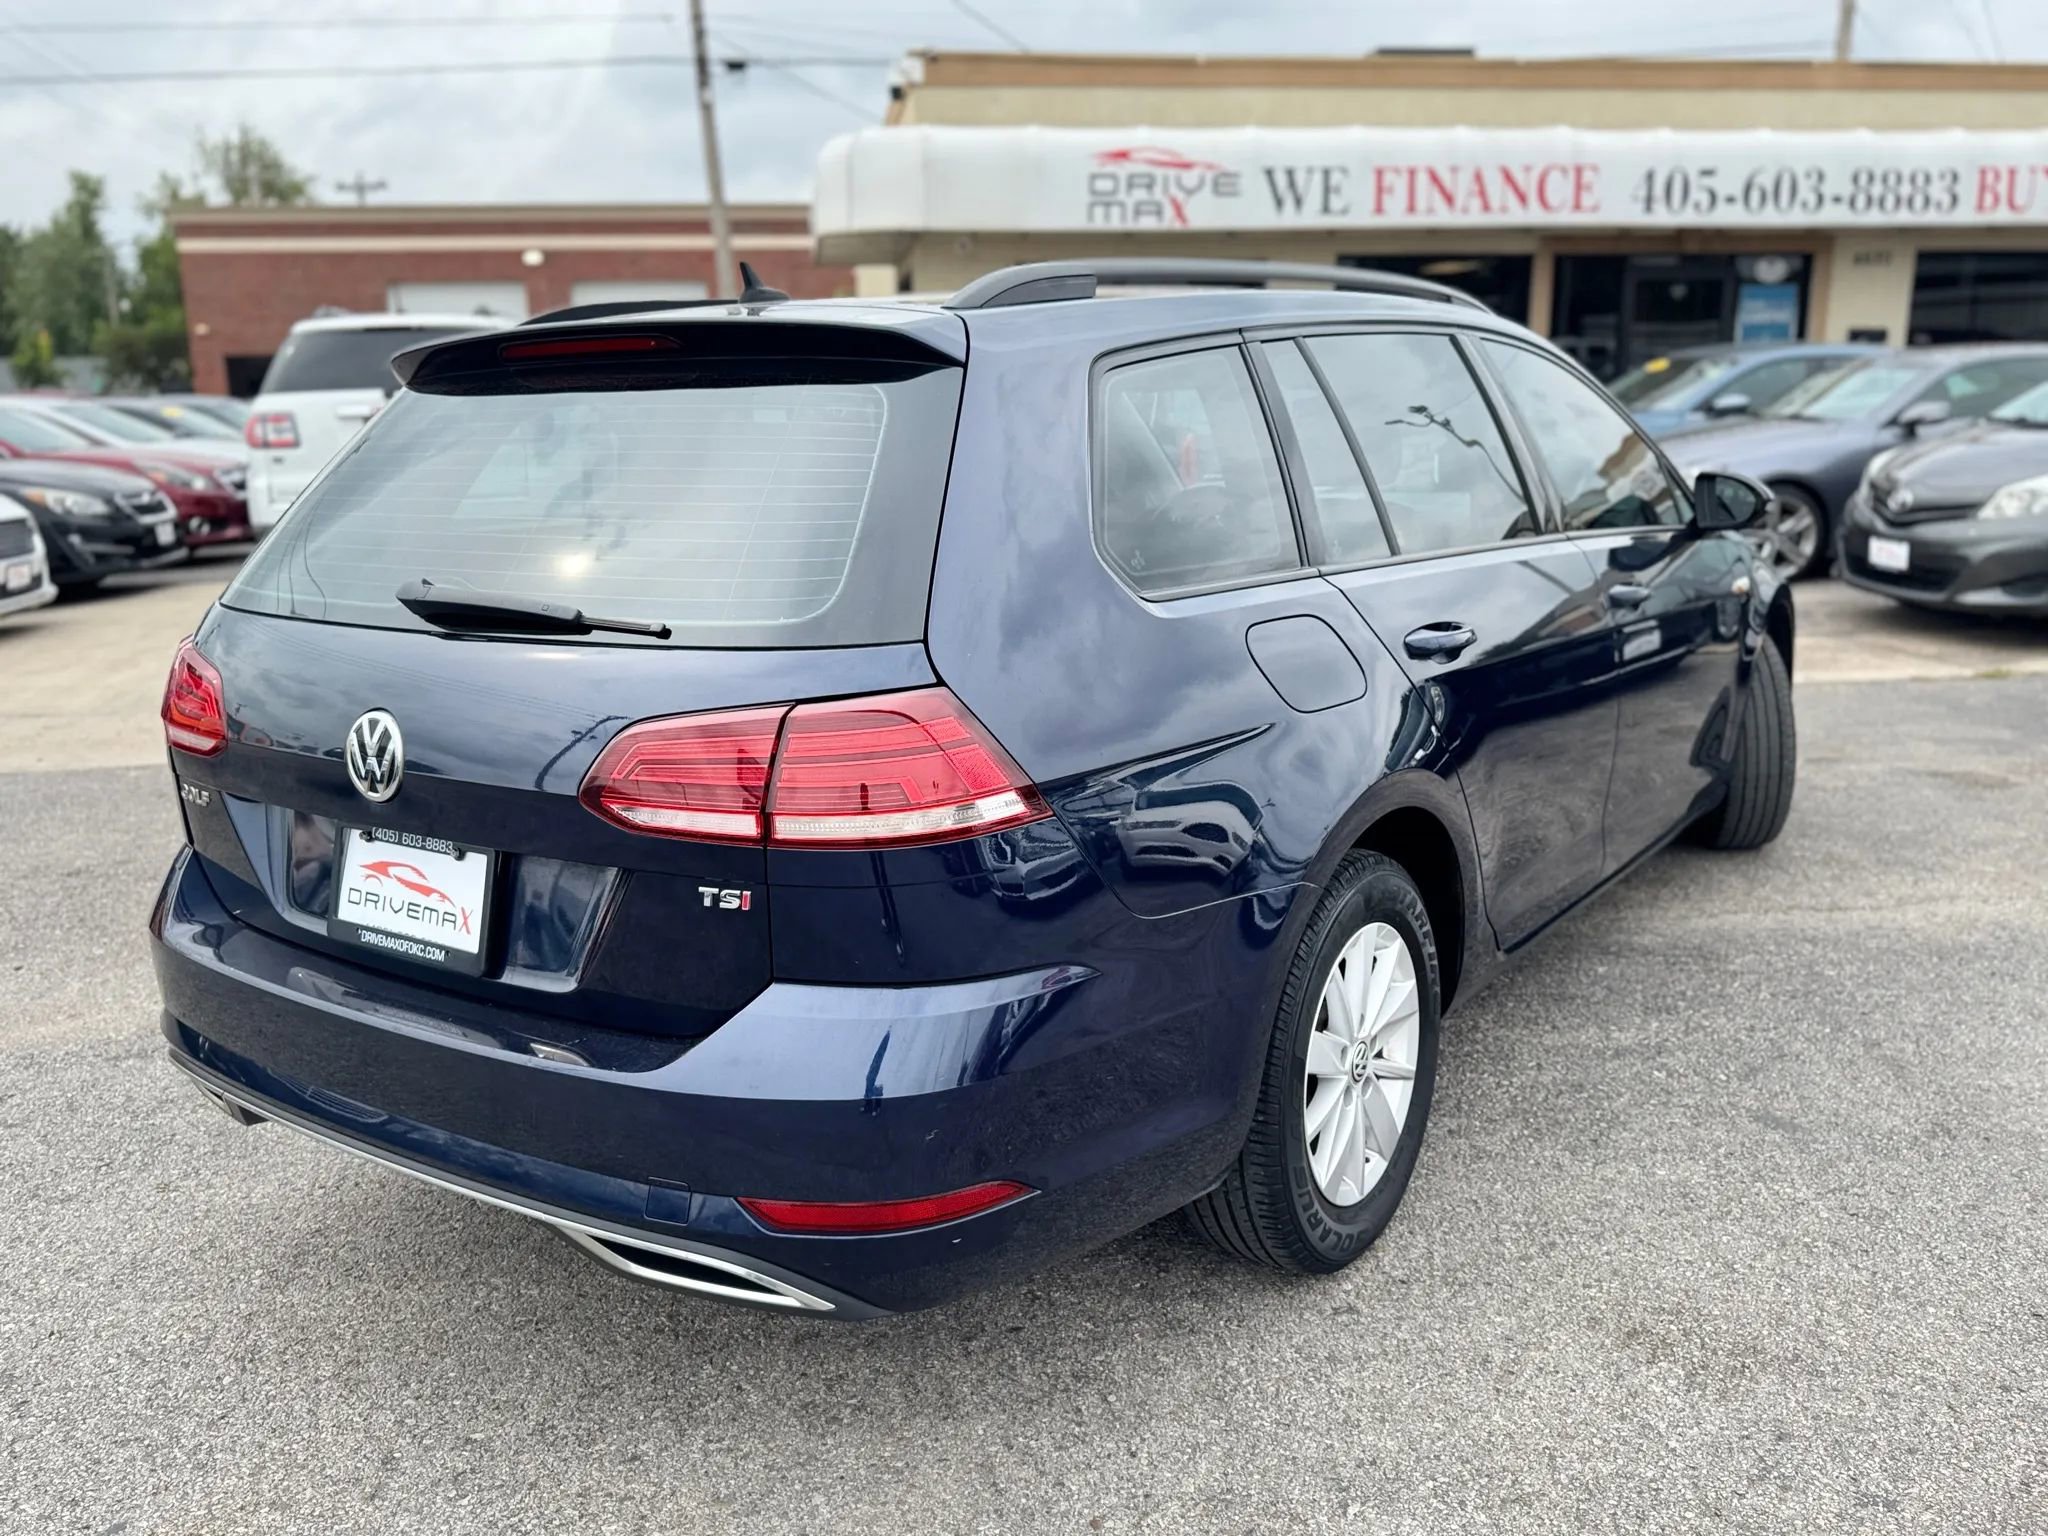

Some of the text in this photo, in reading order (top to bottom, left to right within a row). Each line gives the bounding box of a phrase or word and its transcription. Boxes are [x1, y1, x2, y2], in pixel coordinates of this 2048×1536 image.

[1088, 171, 1242, 197] DRIVE
[1262, 165, 1352, 215] WE
[1371, 164, 1600, 215] FINANCE
[1631, 165, 1961, 215] 405-603-8883
[1086, 198, 1190, 227] MAX
[371, 826, 454, 854] (405) 603-8883
[347, 888, 474, 935] DRIVEMAX
[699, 886, 753, 912] TSI
[360, 930, 446, 962] DRIVEMAXOFOKC.COM
